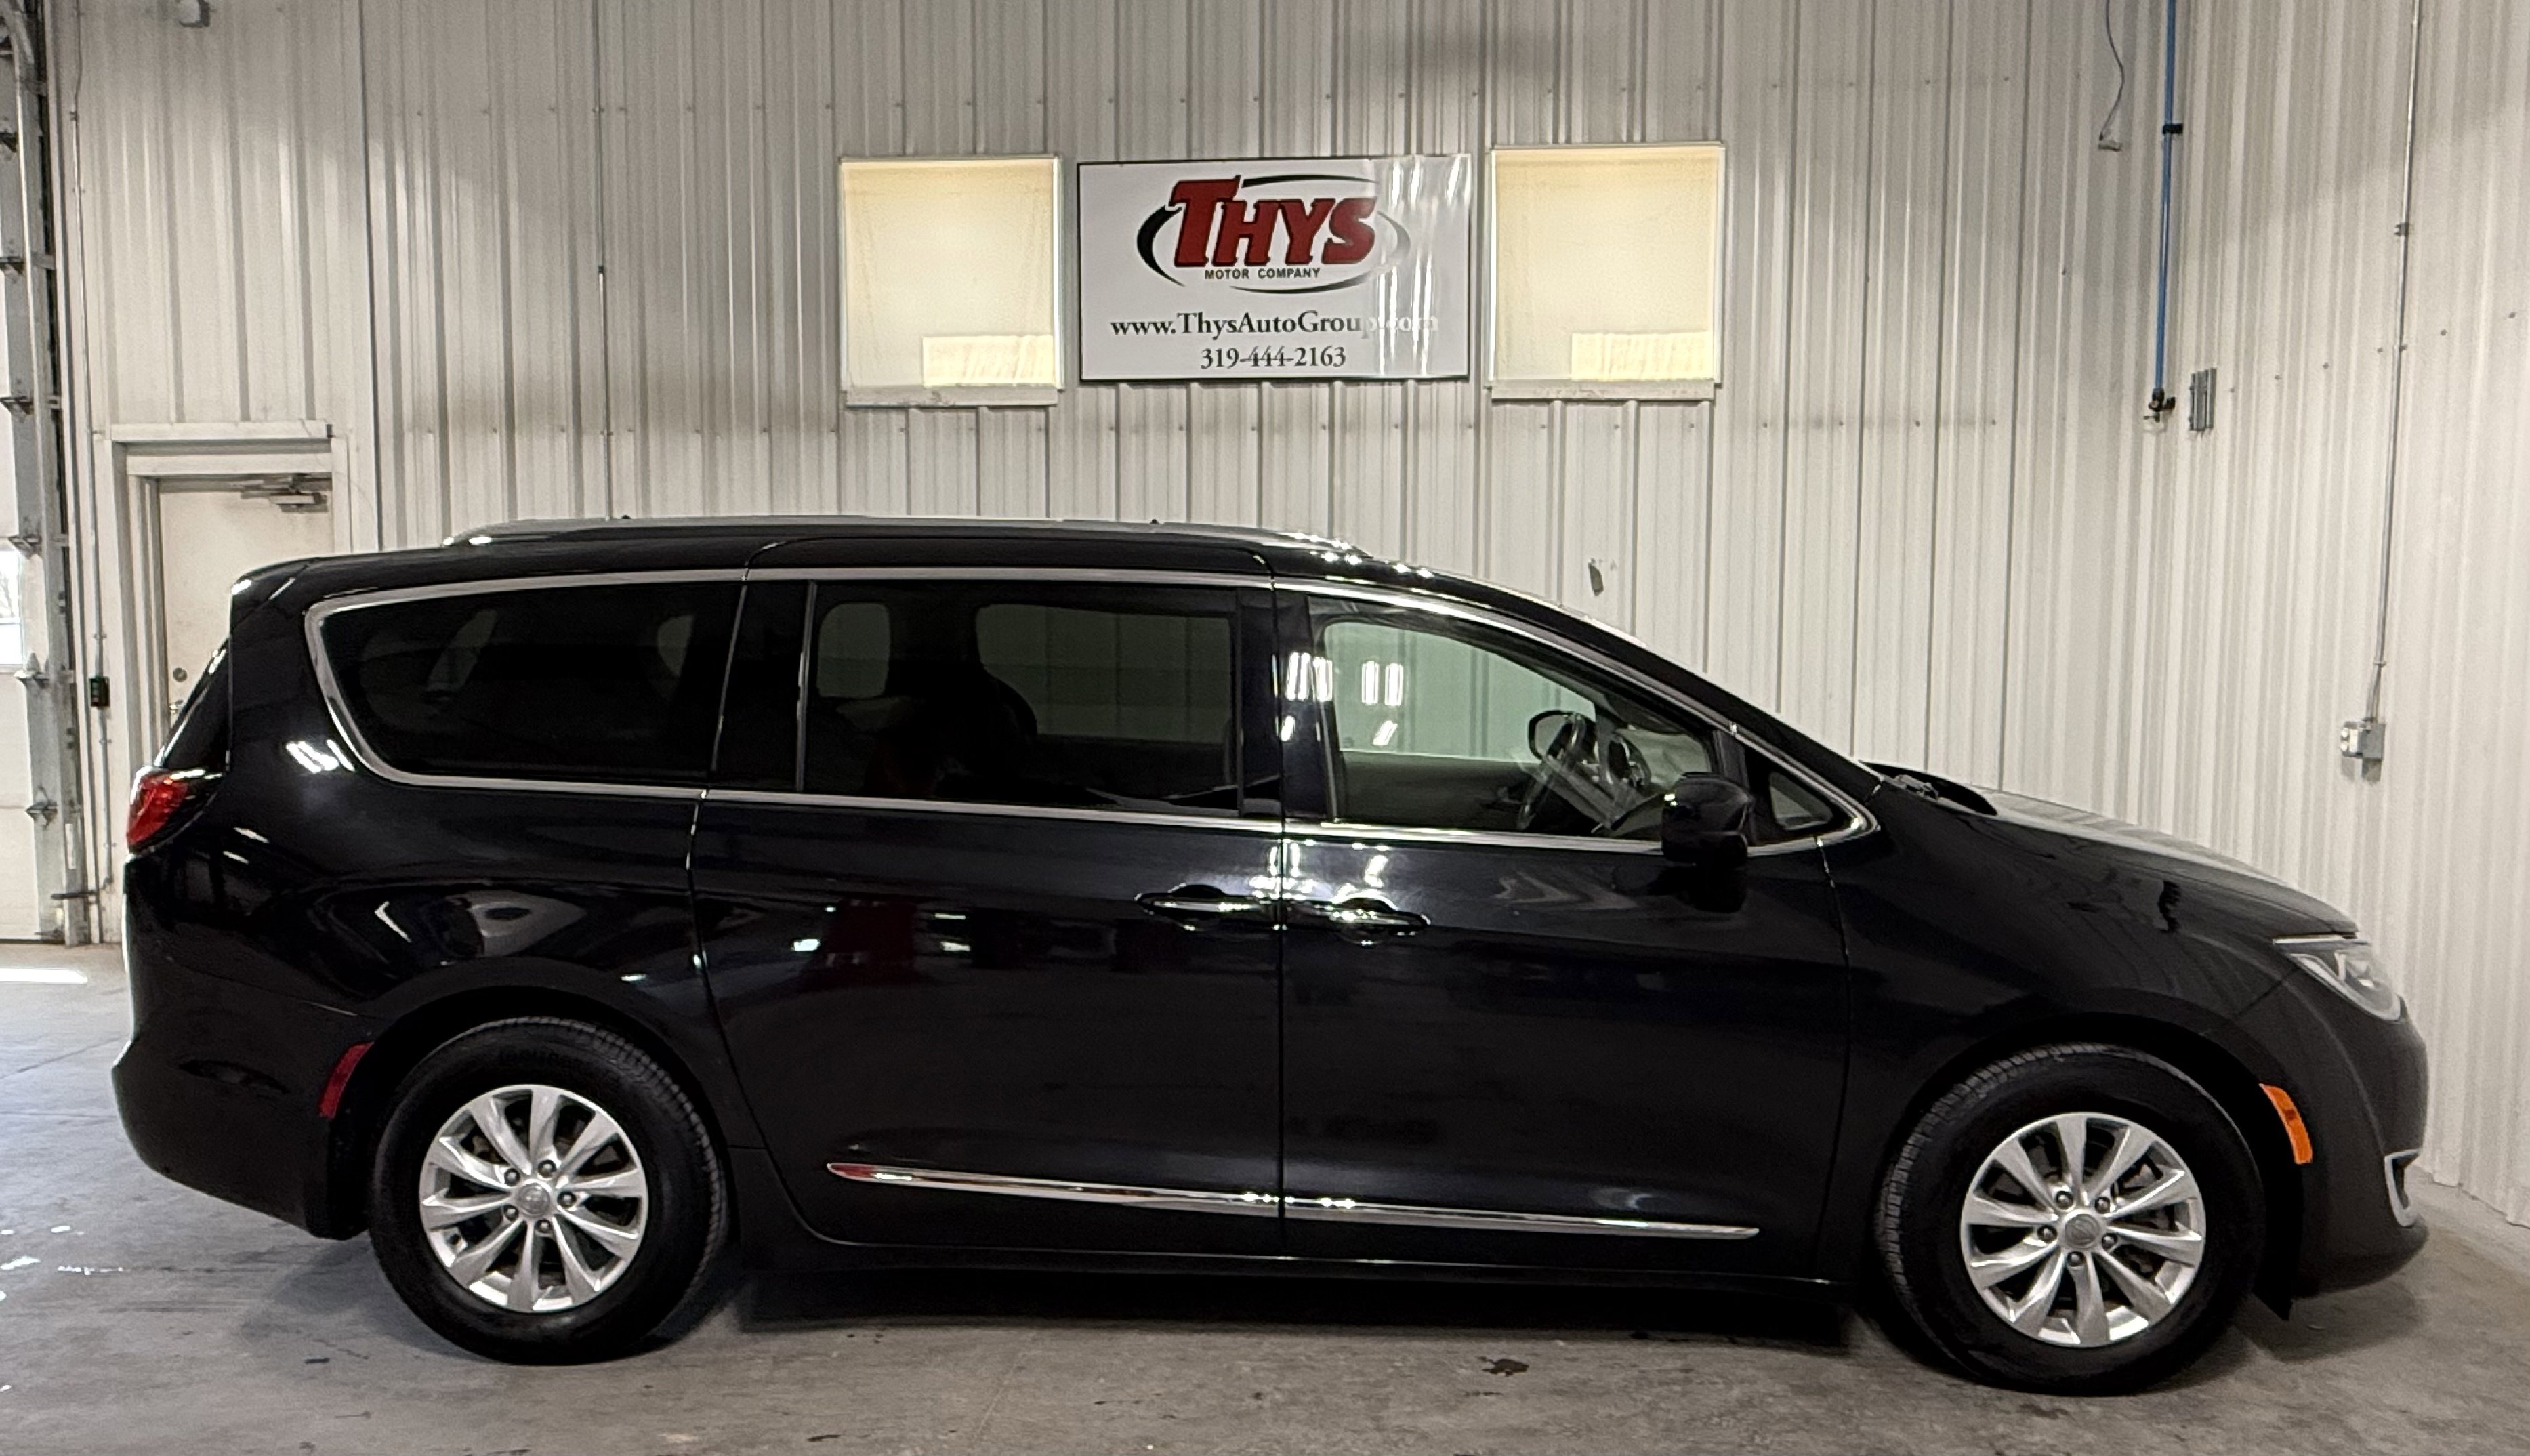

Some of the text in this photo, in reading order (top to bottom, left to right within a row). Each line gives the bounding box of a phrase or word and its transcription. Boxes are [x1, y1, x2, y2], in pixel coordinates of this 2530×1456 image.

[1169, 175, 1377, 267] THYS
[1204, 267, 1321, 280] MOTOR COMPANY
[1110, 310, 1439, 340] www.ThysAutoGroupcom
[1200, 345, 1346, 369] 319-444-2163
